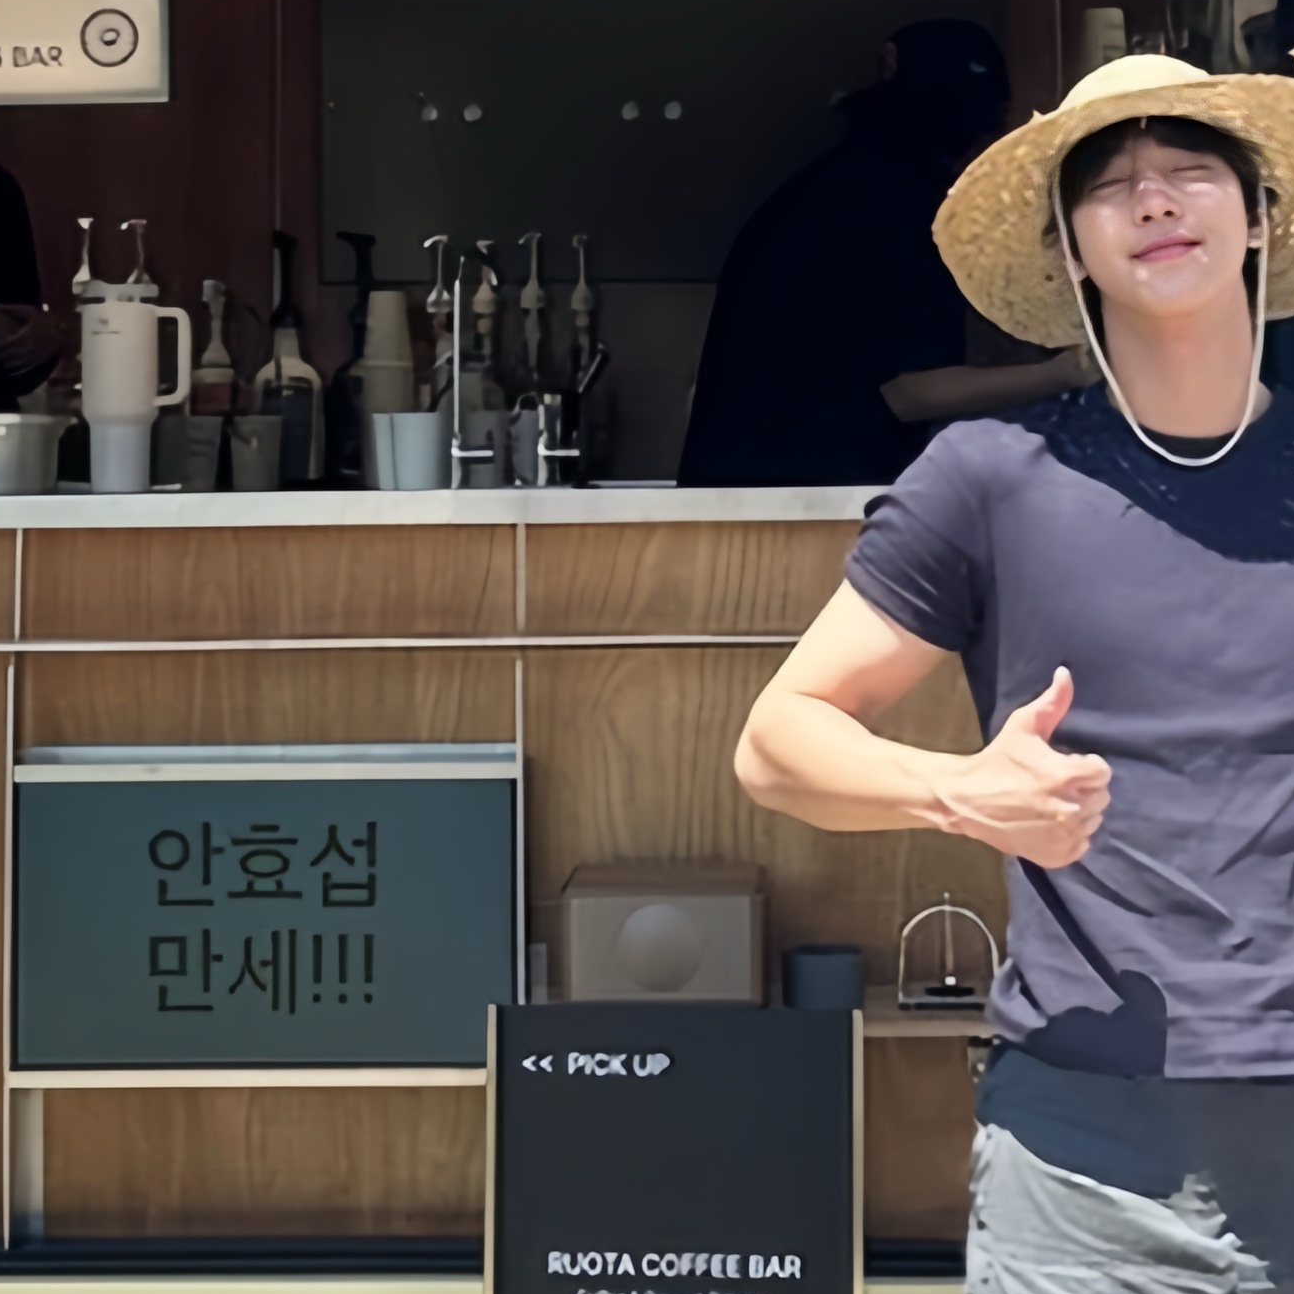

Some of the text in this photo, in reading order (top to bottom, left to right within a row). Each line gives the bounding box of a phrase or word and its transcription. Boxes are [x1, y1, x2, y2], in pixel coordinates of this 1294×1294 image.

[11, 45, 64, 68] BAR
[147, 820, 378, 908] 안효섭
[147, 927, 375, 1015] 만세!!!
[567, 1051, 628, 1077] PICK
[632, 1052, 671, 1078] UP
[547, 1250, 802, 1280] RUOTA COFFEE BAR
